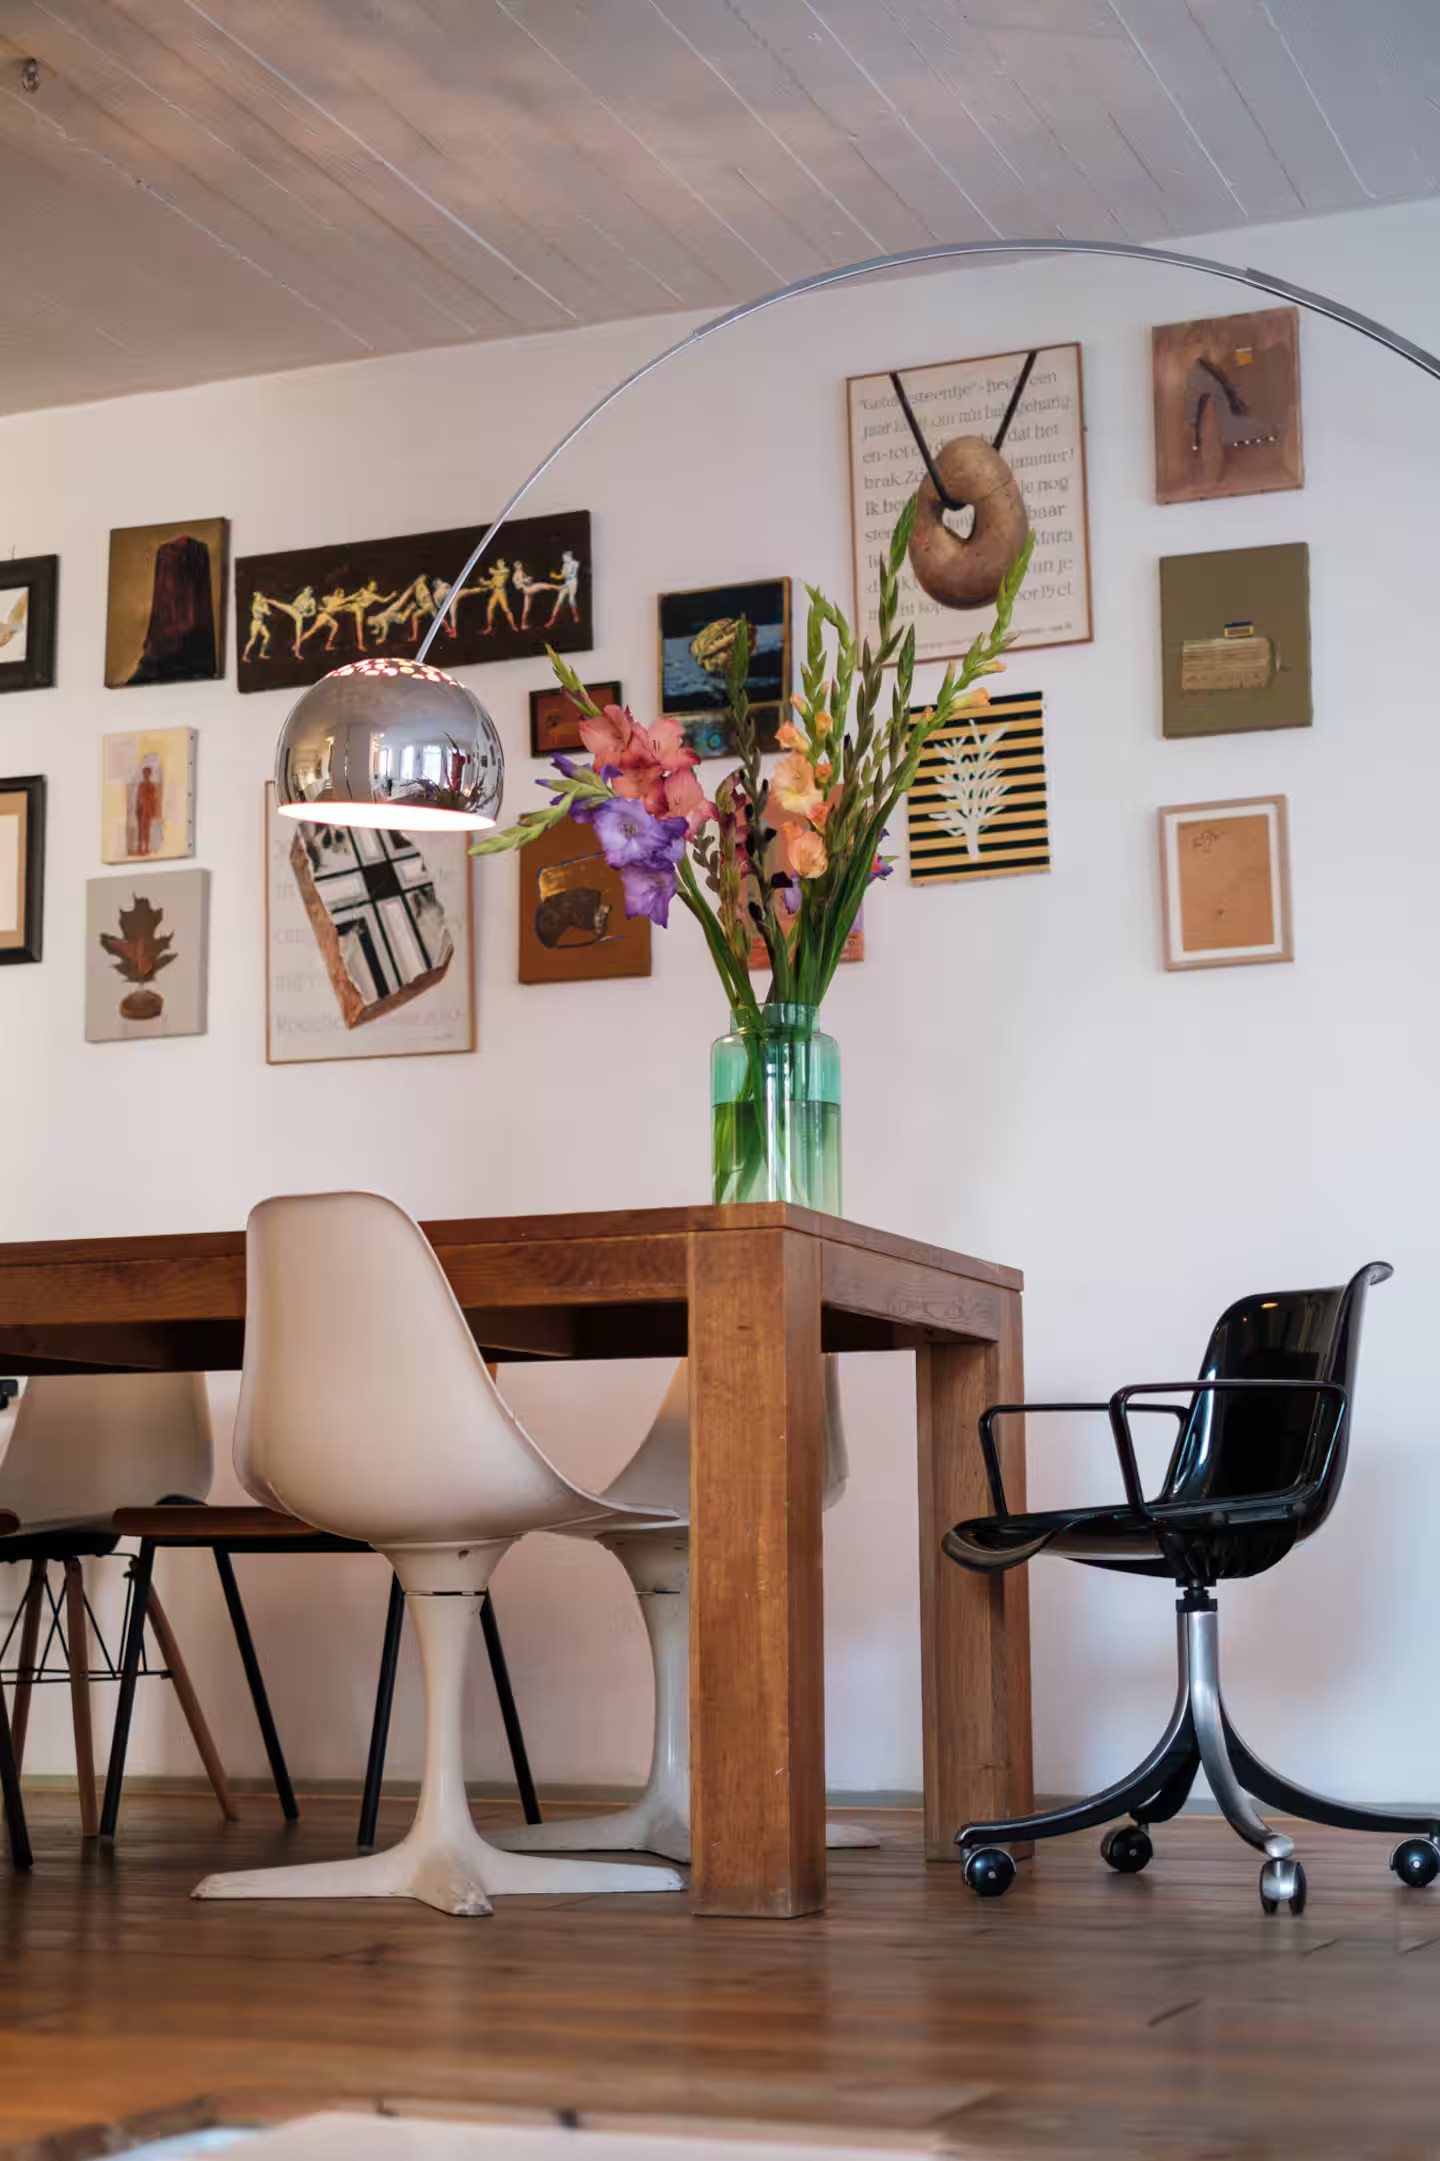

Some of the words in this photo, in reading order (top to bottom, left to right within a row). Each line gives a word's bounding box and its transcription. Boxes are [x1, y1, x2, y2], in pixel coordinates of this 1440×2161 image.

[1007, 426, 1031, 442] dat
[1034, 423, 1059, 440] het
[1038, 476, 1069, 495] nog
